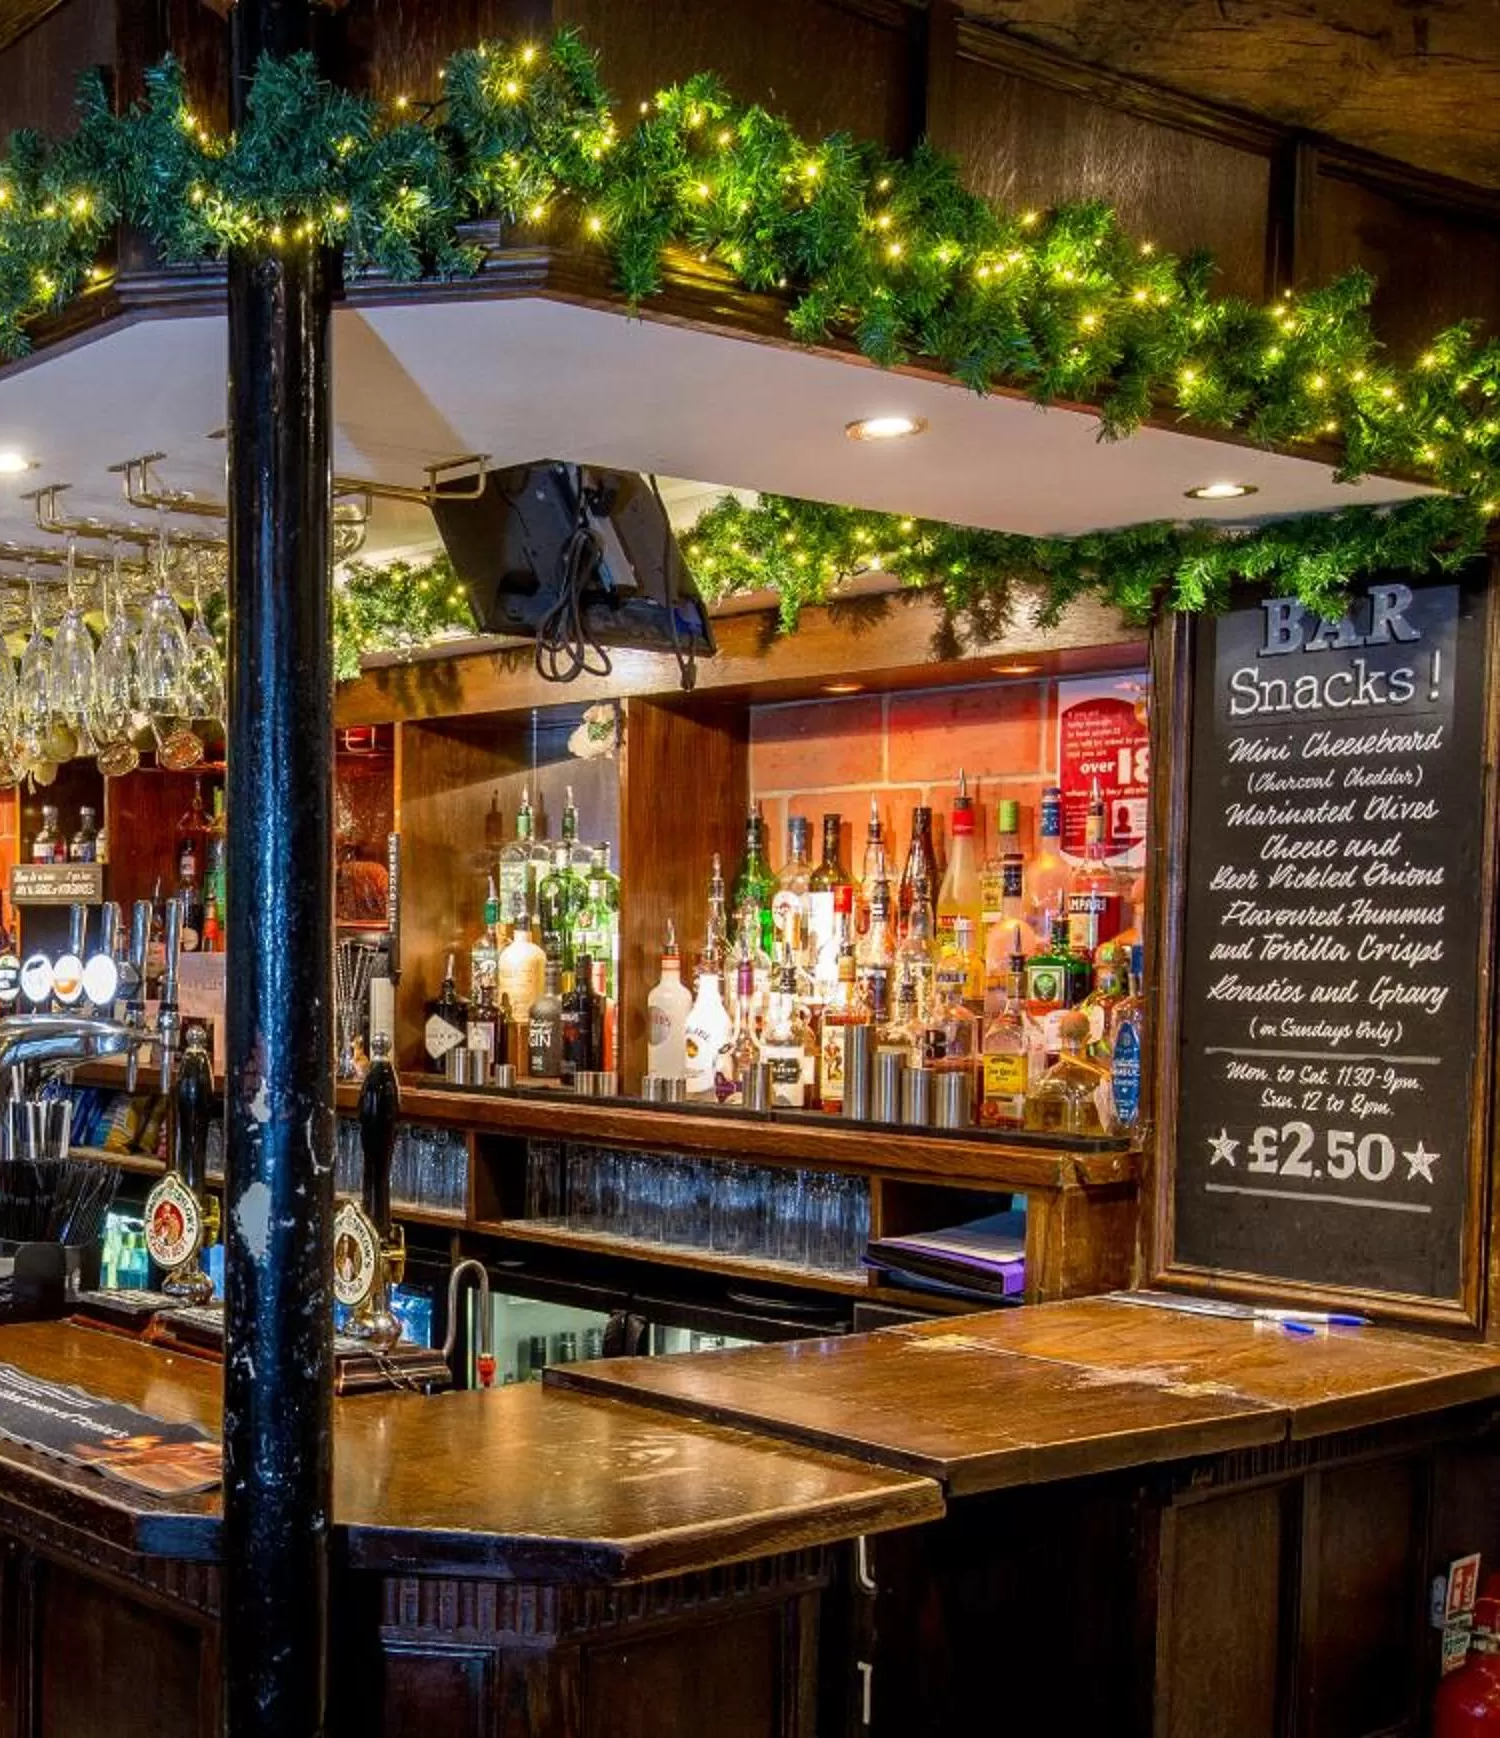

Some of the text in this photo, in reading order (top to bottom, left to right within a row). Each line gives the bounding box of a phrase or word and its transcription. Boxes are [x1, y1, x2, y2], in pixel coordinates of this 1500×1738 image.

[1258, 584, 1420, 656] BAR
[1229, 658, 1417, 716] Snacks
[1228, 726, 1443, 763] Mini Cheeseboard
[1079, 761, 1116, 775] over
[1246, 764, 1423, 794] (Charcoal Cheddar)
[1225, 795, 1440, 828] Marinated Olives
[1260, 832, 1402, 861] Cheese and
[1209, 860, 1445, 891] Beer Pickled Onions
[1221, 898, 1446, 927] Flavoured Hummus
[1209, 933, 1445, 968] and Tortilla Crisps
[1206, 974, 1450, 1014] Roasties and Gravy
[1276, 1017, 1354, 1046] Sundays
[1277, 1063, 1293, 1083] to
[1301, 1091, 1323, 1111] 12
[1326, 1094, 1345, 1112] to
[1247, 1121, 1396, 1182] £2.50
